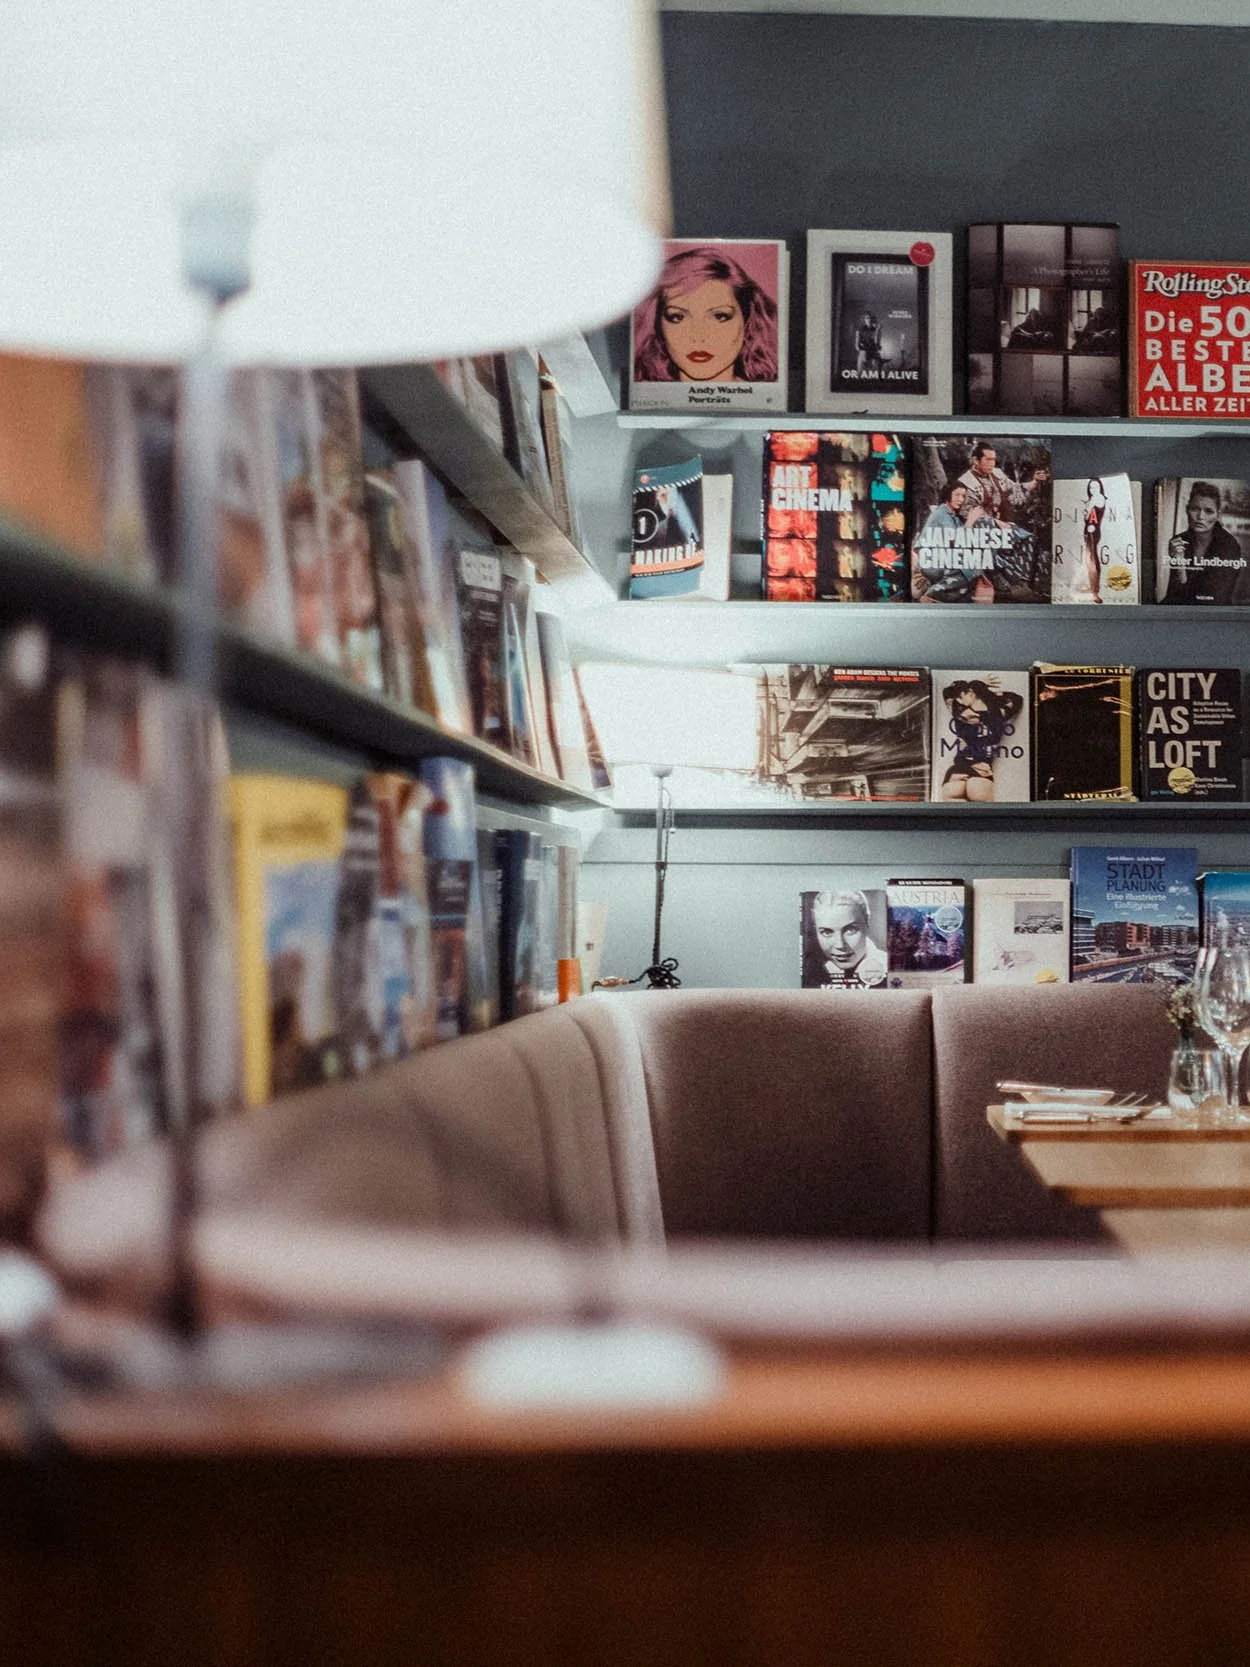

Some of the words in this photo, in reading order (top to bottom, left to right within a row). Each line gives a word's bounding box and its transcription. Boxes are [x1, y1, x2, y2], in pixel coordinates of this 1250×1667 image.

[848, 265, 865, 274] DO
[867, 265, 872, 274] I
[874, 266, 914, 275] DREAM
[1145, 310, 1193, 332] Die
[842, 369, 859, 380] OR
[860, 370, 878, 380] AM
[887, 370, 919, 381] ALIVE
[688, 386, 715, 396] Andy
[717, 386, 753, 395] Warhol
[1145, 397, 1208, 412] ALLER
[772, 465, 812, 488] ART
[772, 488, 853, 512] CINEMA
[920, 527, 1013, 549] JAPANESE
[919, 548, 995, 570] CINEMA
[1163, 555, 1192, 567] Peter
[1194, 556, 1248, 570] Lindbergh
[1147, 672, 1216, 701] CITY
[1147, 706, 1190, 735] AS
[1148, 740, 1222, 769] LOFT
[1107, 863, 1166, 880] STADT
[1107, 879, 1166, 893] PLANUNG
[891, 890, 961, 904] AUSTRIA
